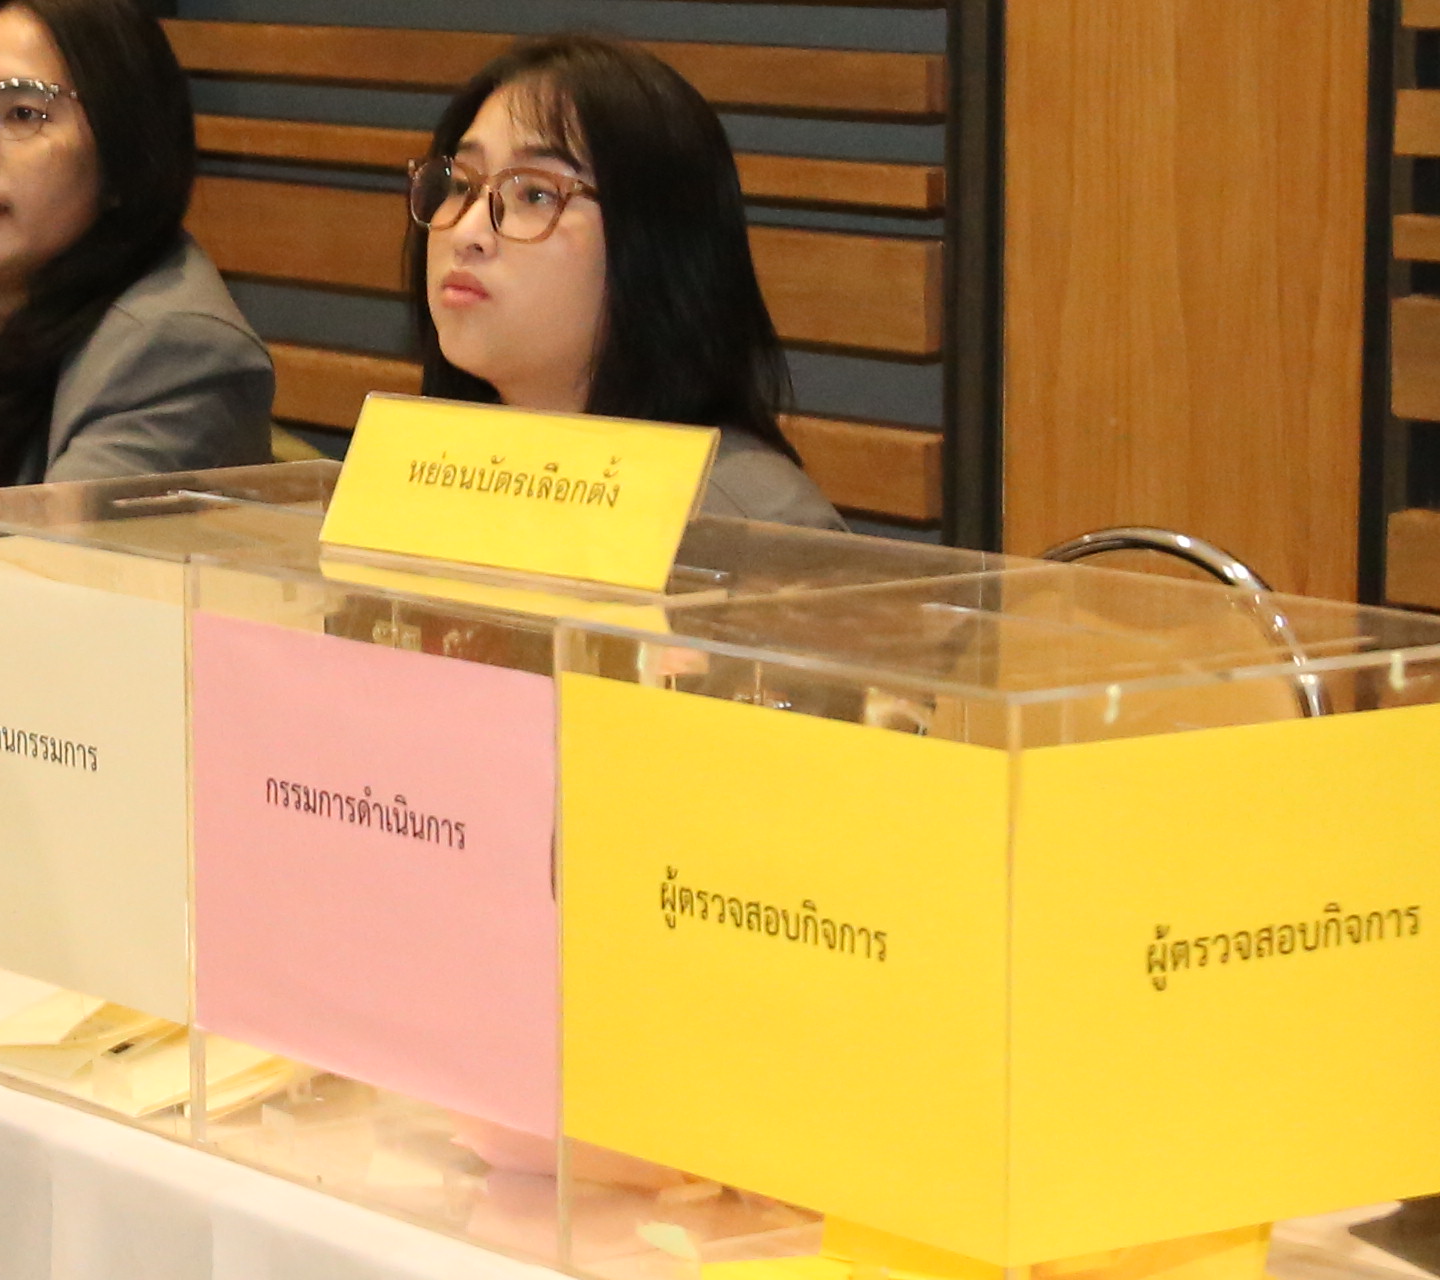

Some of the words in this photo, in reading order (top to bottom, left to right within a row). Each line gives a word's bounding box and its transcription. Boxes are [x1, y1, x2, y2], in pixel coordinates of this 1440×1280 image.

[408, 452, 620, 508] หย่อนบัตรเลือกตั้ง
[266, 777, 466, 851] กรรมการดำเนินการ
[660, 865, 887, 963] ผู้ตรวจสอบกิจการ
[1145, 902, 1421, 992] ผู้ตรวจสอบกิจการ
